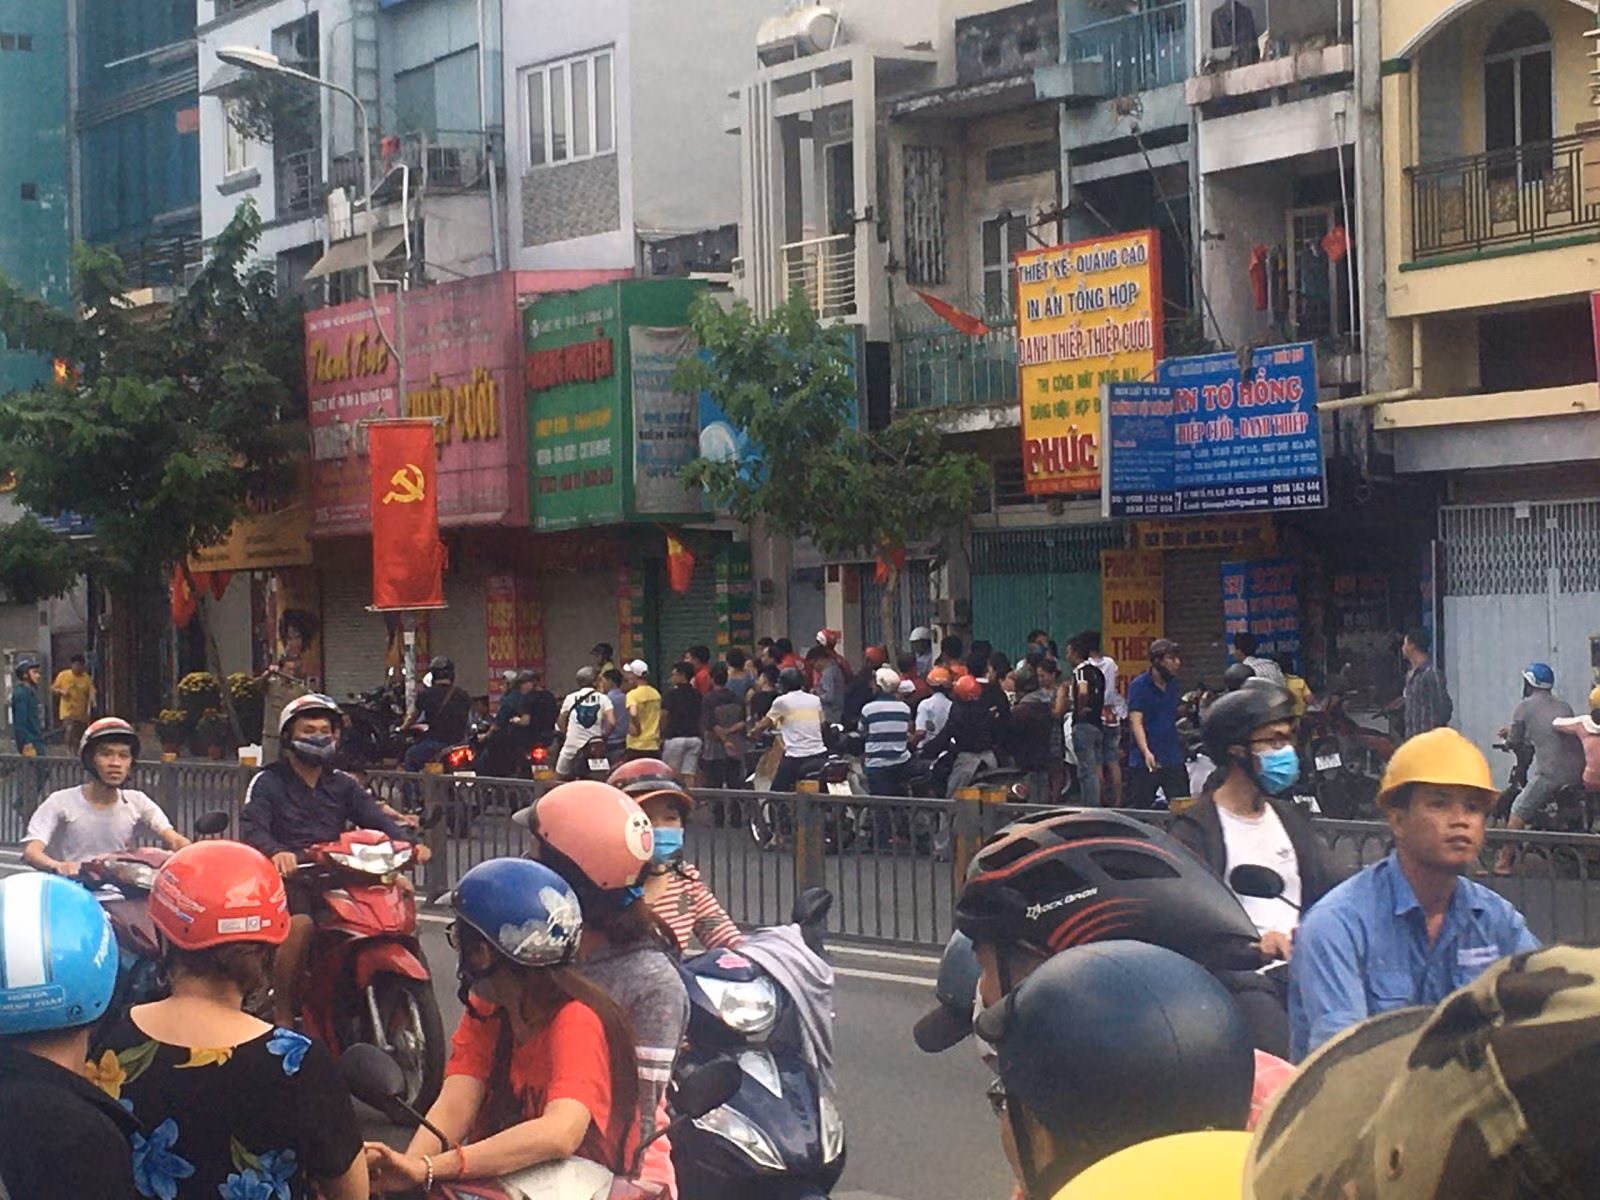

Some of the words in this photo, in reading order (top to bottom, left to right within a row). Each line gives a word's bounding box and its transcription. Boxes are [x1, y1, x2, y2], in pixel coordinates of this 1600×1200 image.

[1018, 255, 1049, 283] THIẾT
[1076, 244, 1118, 274] QUẢNG
[1027, 299, 1040, 320] IN
[1045, 287, 1064, 316] ẤN
[1067, 279, 1105, 312] TỔNG
[1109, 280, 1138, 312] HỢP
[1019, 335, 1049, 366] DANH
[1202, 378, 1234, 411] TƠ
[1237, 367, 1304, 407] HỒNG
[1023, 424, 1098, 475] PHÚC
